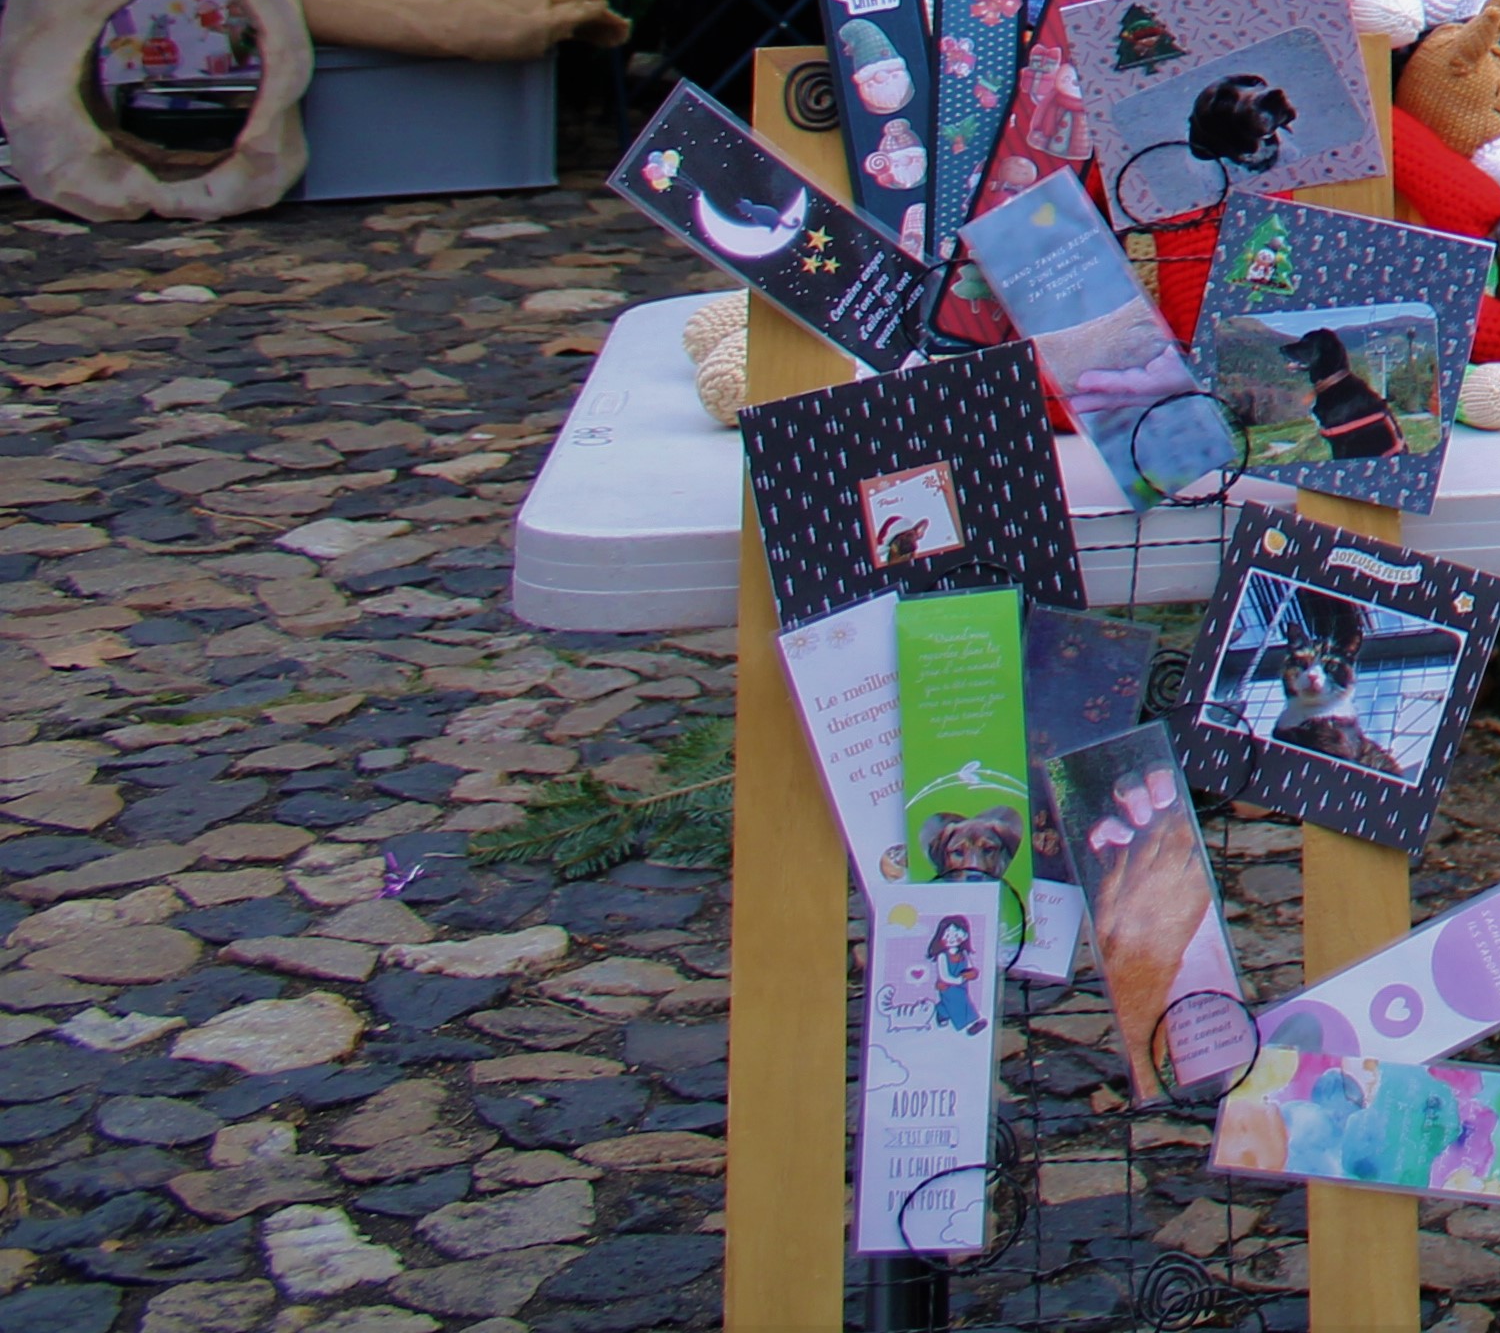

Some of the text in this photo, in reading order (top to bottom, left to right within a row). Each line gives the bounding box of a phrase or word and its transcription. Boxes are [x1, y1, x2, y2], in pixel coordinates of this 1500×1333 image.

[828, 249, 887, 322] Certains anges
[871, 272, 891, 295] pas
[893, 270, 913, 292] ont
[1331, 547, 1383, 573] JOYEUSES
[814, 670, 901, 711] Le meilleu
[843, 736, 874, 757] une
[847, 765, 867, 783] et
[1466, 919, 1481, 938] ILS
[891, 1089, 957, 1117] ADOPTER
[889, 1156, 902, 1177] LA
[920, 1188, 956, 1210] FOYER
